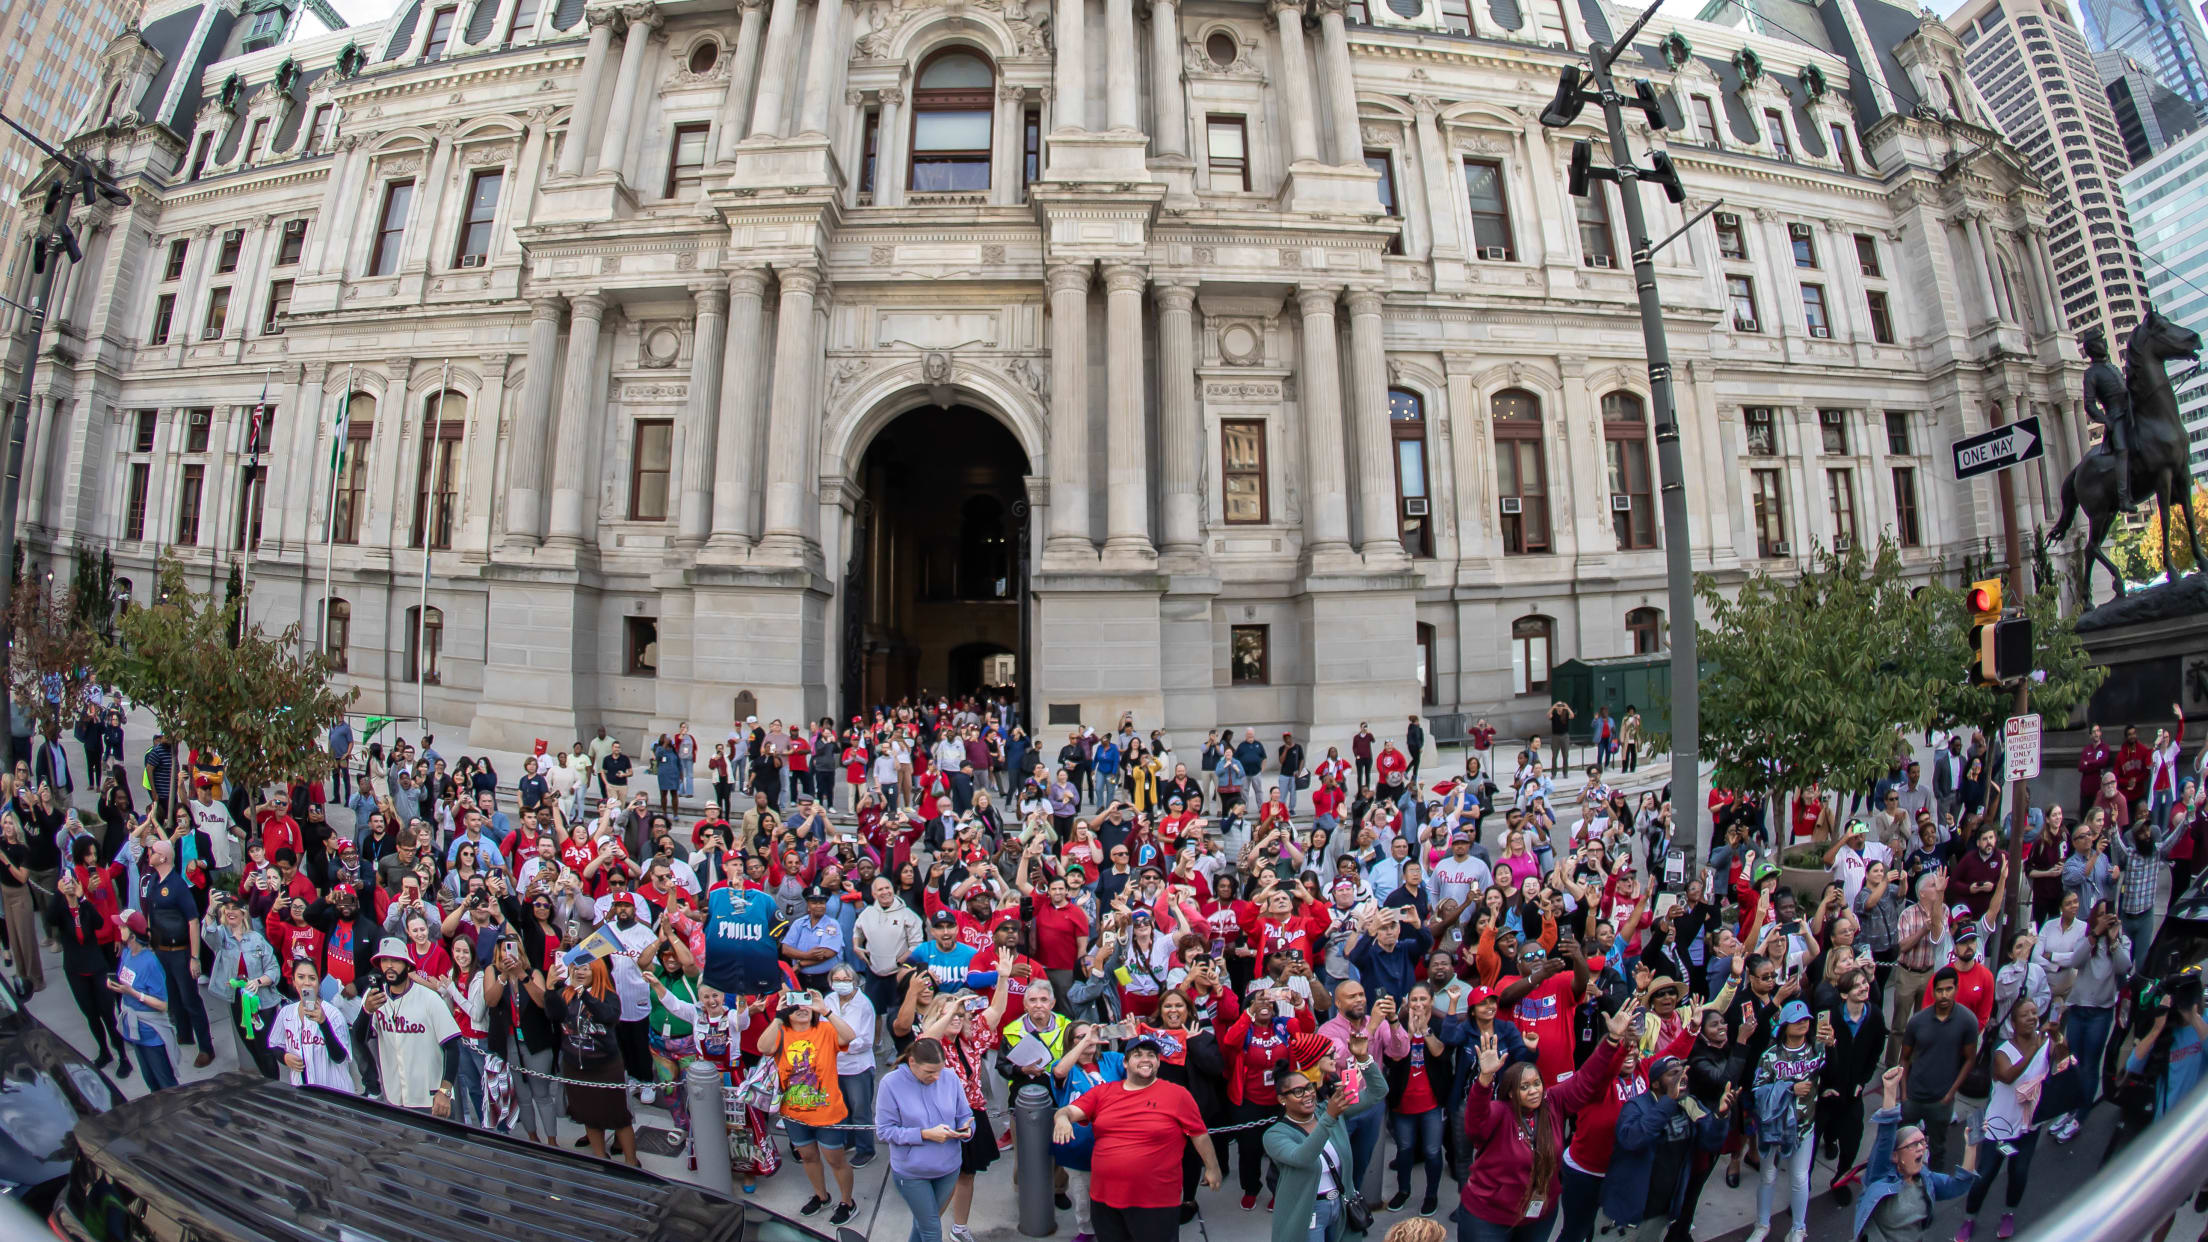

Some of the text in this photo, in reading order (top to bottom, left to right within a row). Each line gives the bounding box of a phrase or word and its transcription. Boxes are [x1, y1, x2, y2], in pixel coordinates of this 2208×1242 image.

[1962, 436, 2013, 466] ONE WAY
[2007, 720, 2018, 734] NO
[2008, 734, 2037, 744] AUTHORIZED
[2009, 742, 2037, 751] VEHICLES
[2010, 758, 2027, 767] ZONE
[565, 846, 592, 861] EAST
[1138, 844, 1156, 866] P
[718, 921, 762, 941] PHILLY
[375, 1009, 425, 1034] Phillies
[286, 1029, 325, 1051] Phillies
